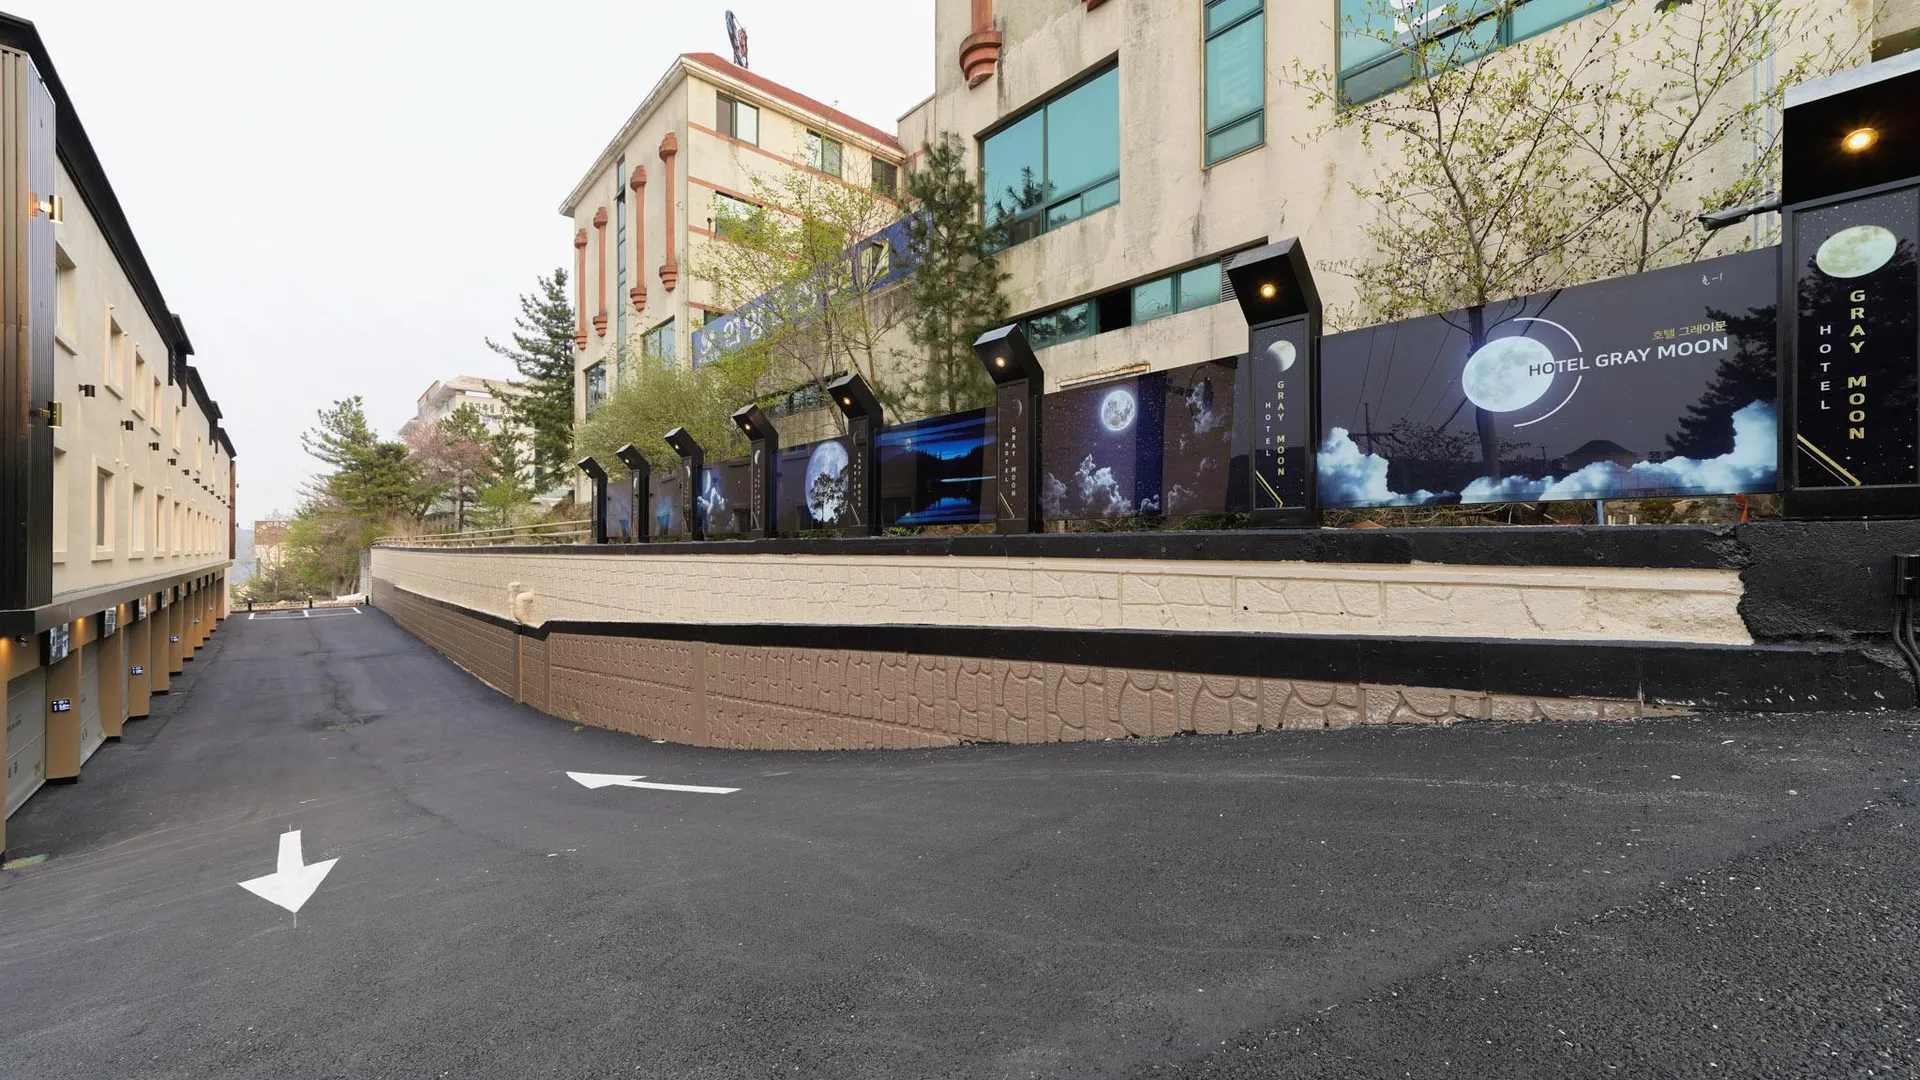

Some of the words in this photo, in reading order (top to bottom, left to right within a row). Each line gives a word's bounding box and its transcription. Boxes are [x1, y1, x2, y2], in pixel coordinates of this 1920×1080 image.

[1652, 328, 1675, 340] 호텔
[1678, 320, 1728, 336] 그레이문
[1849, 289, 1866, 354] GRAY
[1529, 357, 1590, 377] HOTEL
[1595, 347, 1651, 368] GRAY
[1657, 336, 1728, 360] MOON
[1819, 324, 1832, 410] HOTEL
[1277, 380, 1285, 422] GRAY
[1847, 375, 1867, 440] MOON
[1276, 435, 1286, 476] MOON
